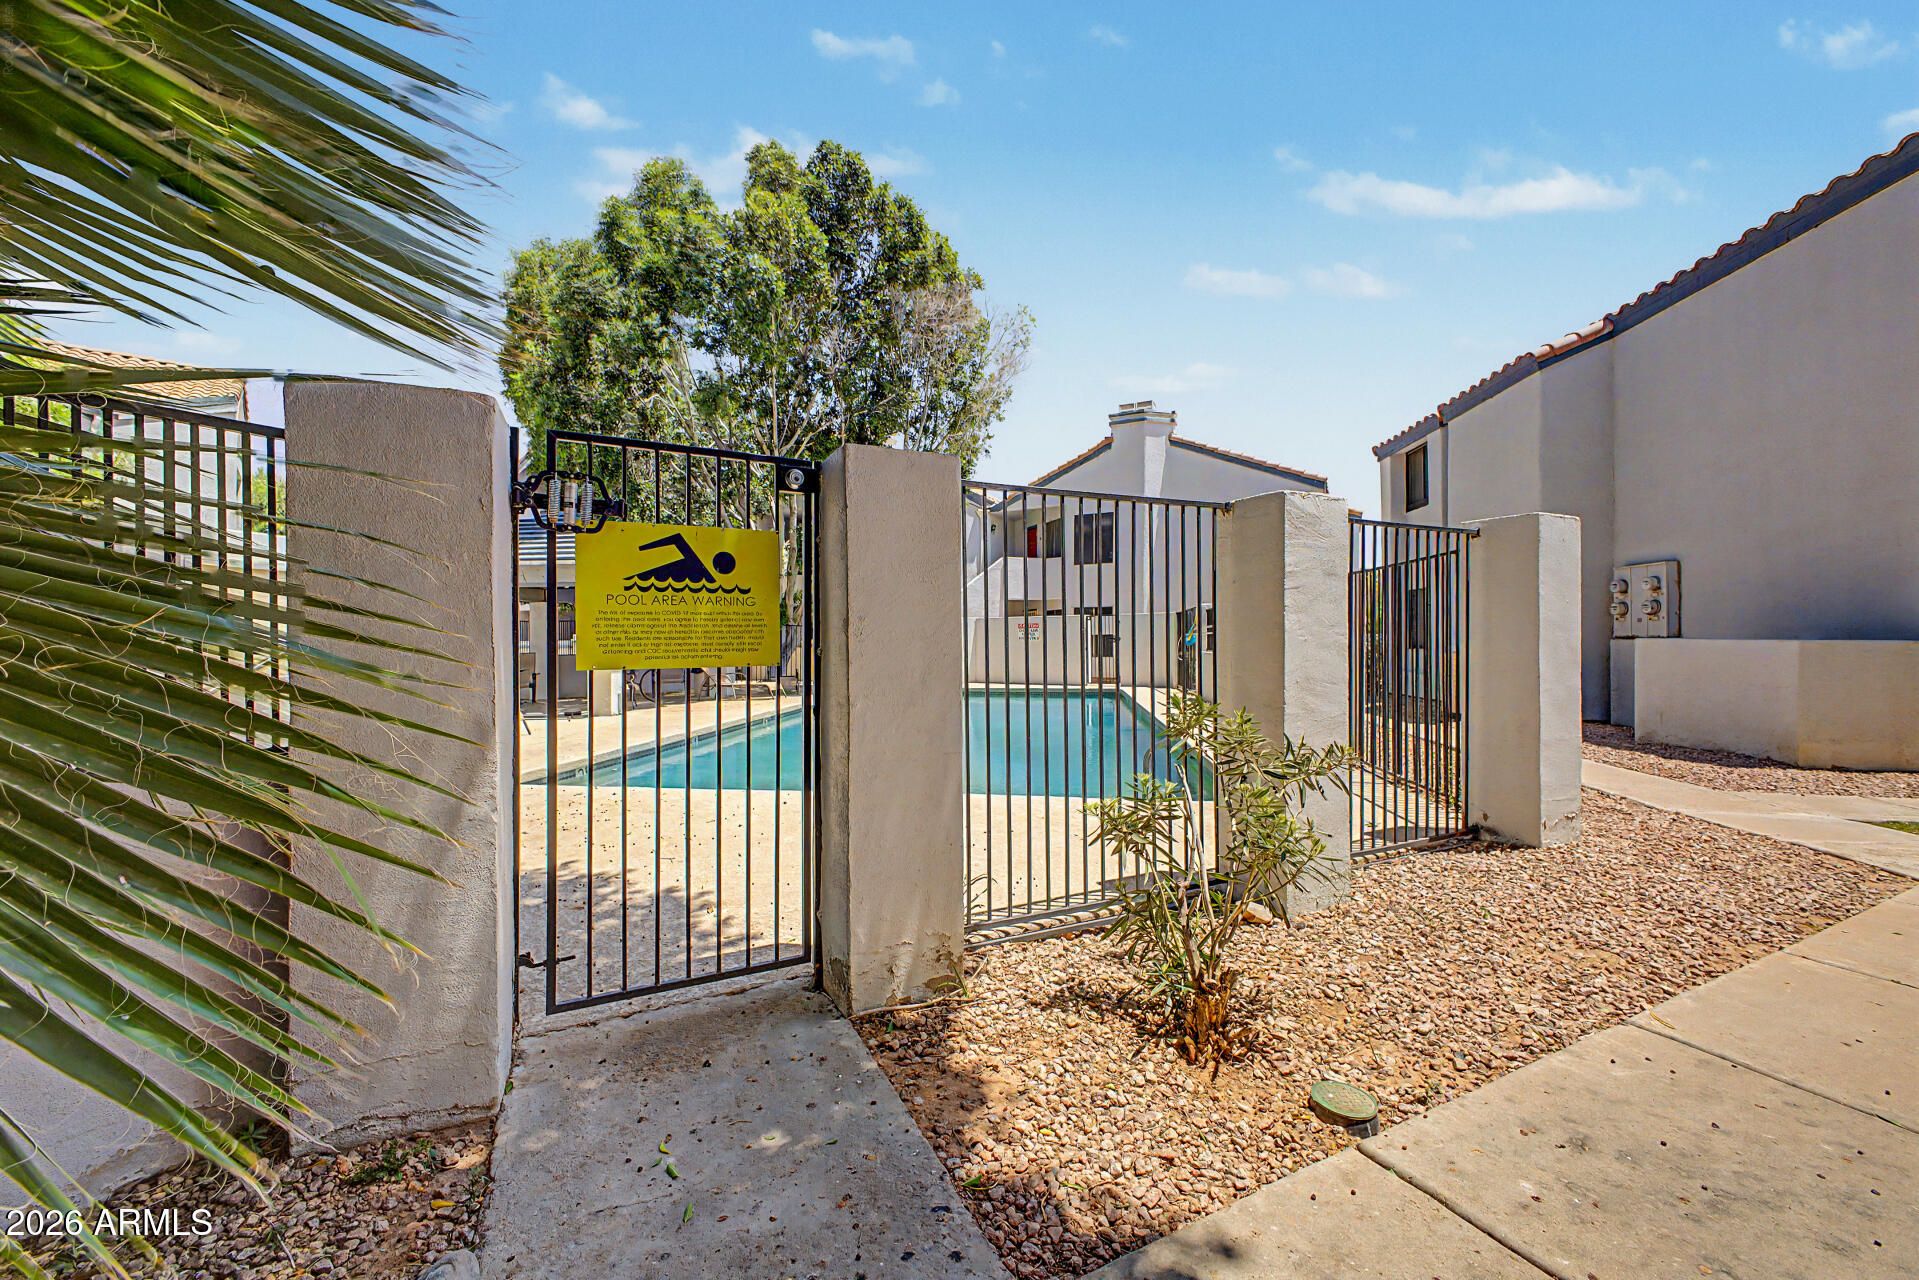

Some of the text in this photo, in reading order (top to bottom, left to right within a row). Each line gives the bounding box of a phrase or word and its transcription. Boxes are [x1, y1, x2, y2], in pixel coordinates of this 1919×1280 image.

[606, 594, 756, 606] POOL AREA WARNING
